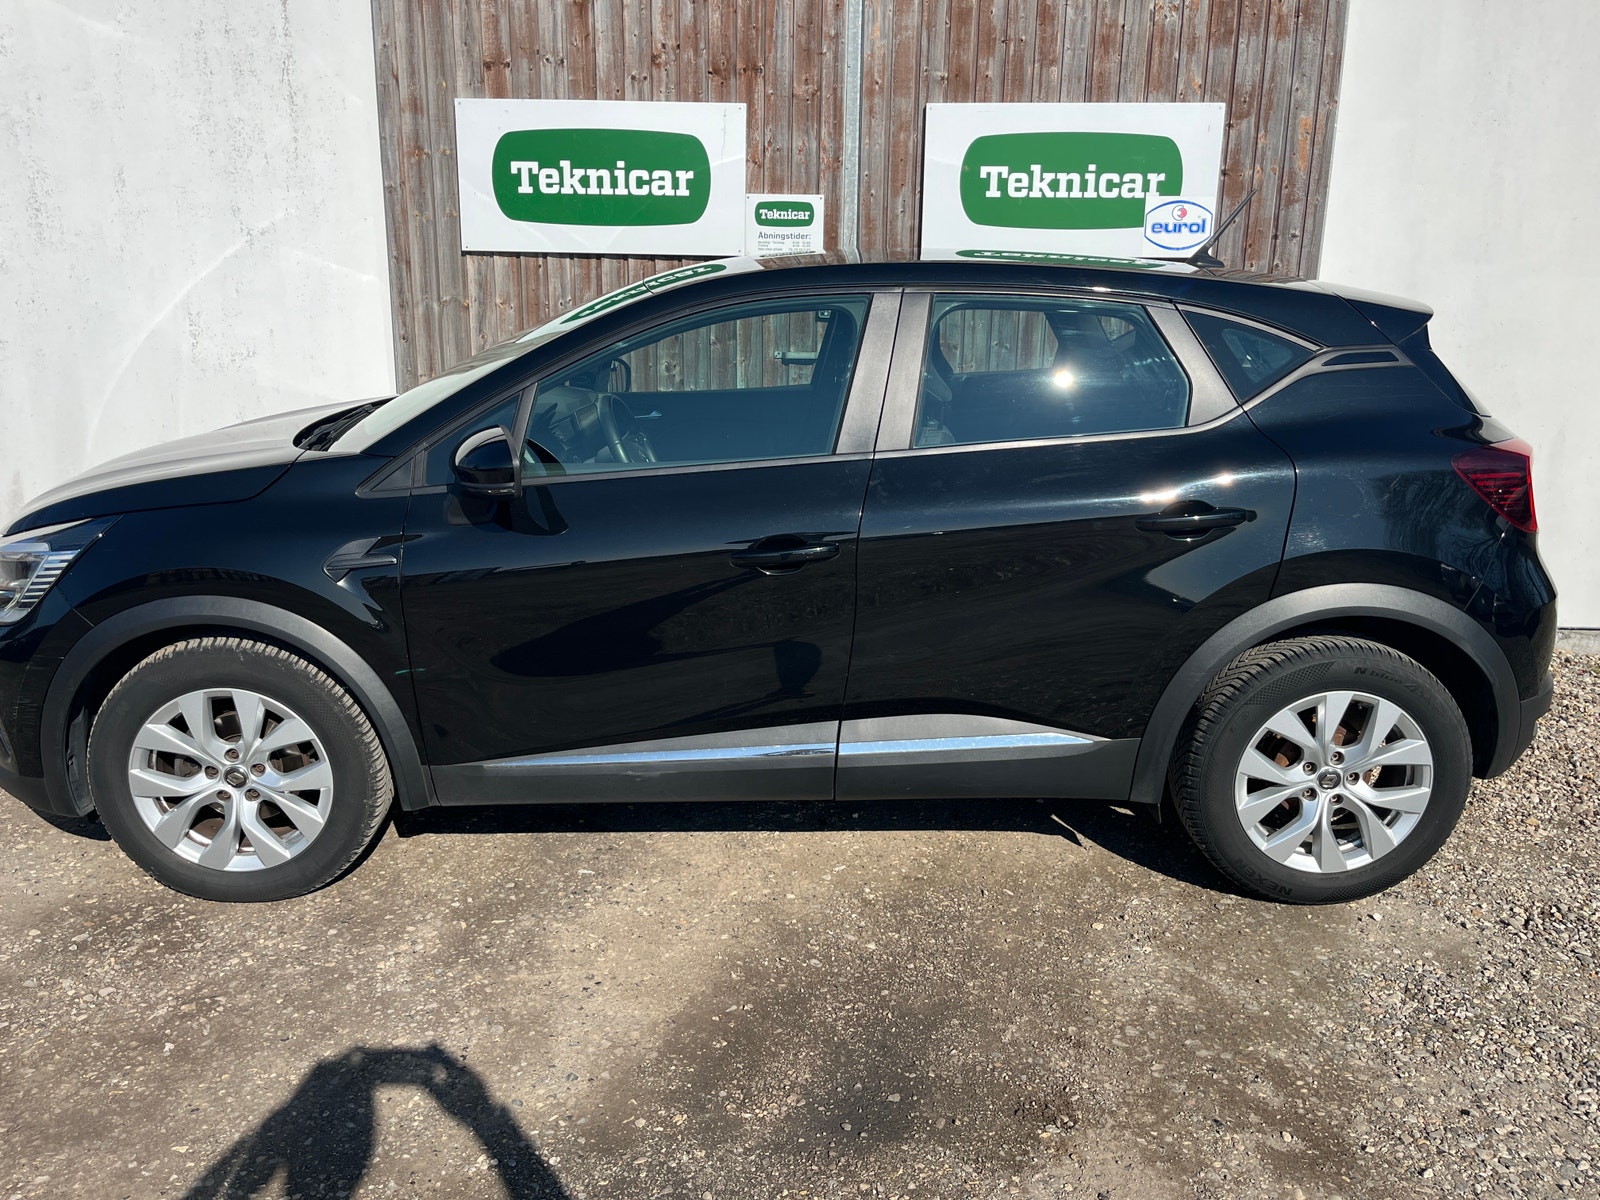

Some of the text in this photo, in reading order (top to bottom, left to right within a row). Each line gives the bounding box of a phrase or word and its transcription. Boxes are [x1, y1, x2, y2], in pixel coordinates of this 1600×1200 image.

[510, 160, 694, 196] Teknicar
[980, 164, 1165, 198] Teknicar
[759, 209, 810, 219] Teknicar
[1151, 218, 1207, 234] eurol
